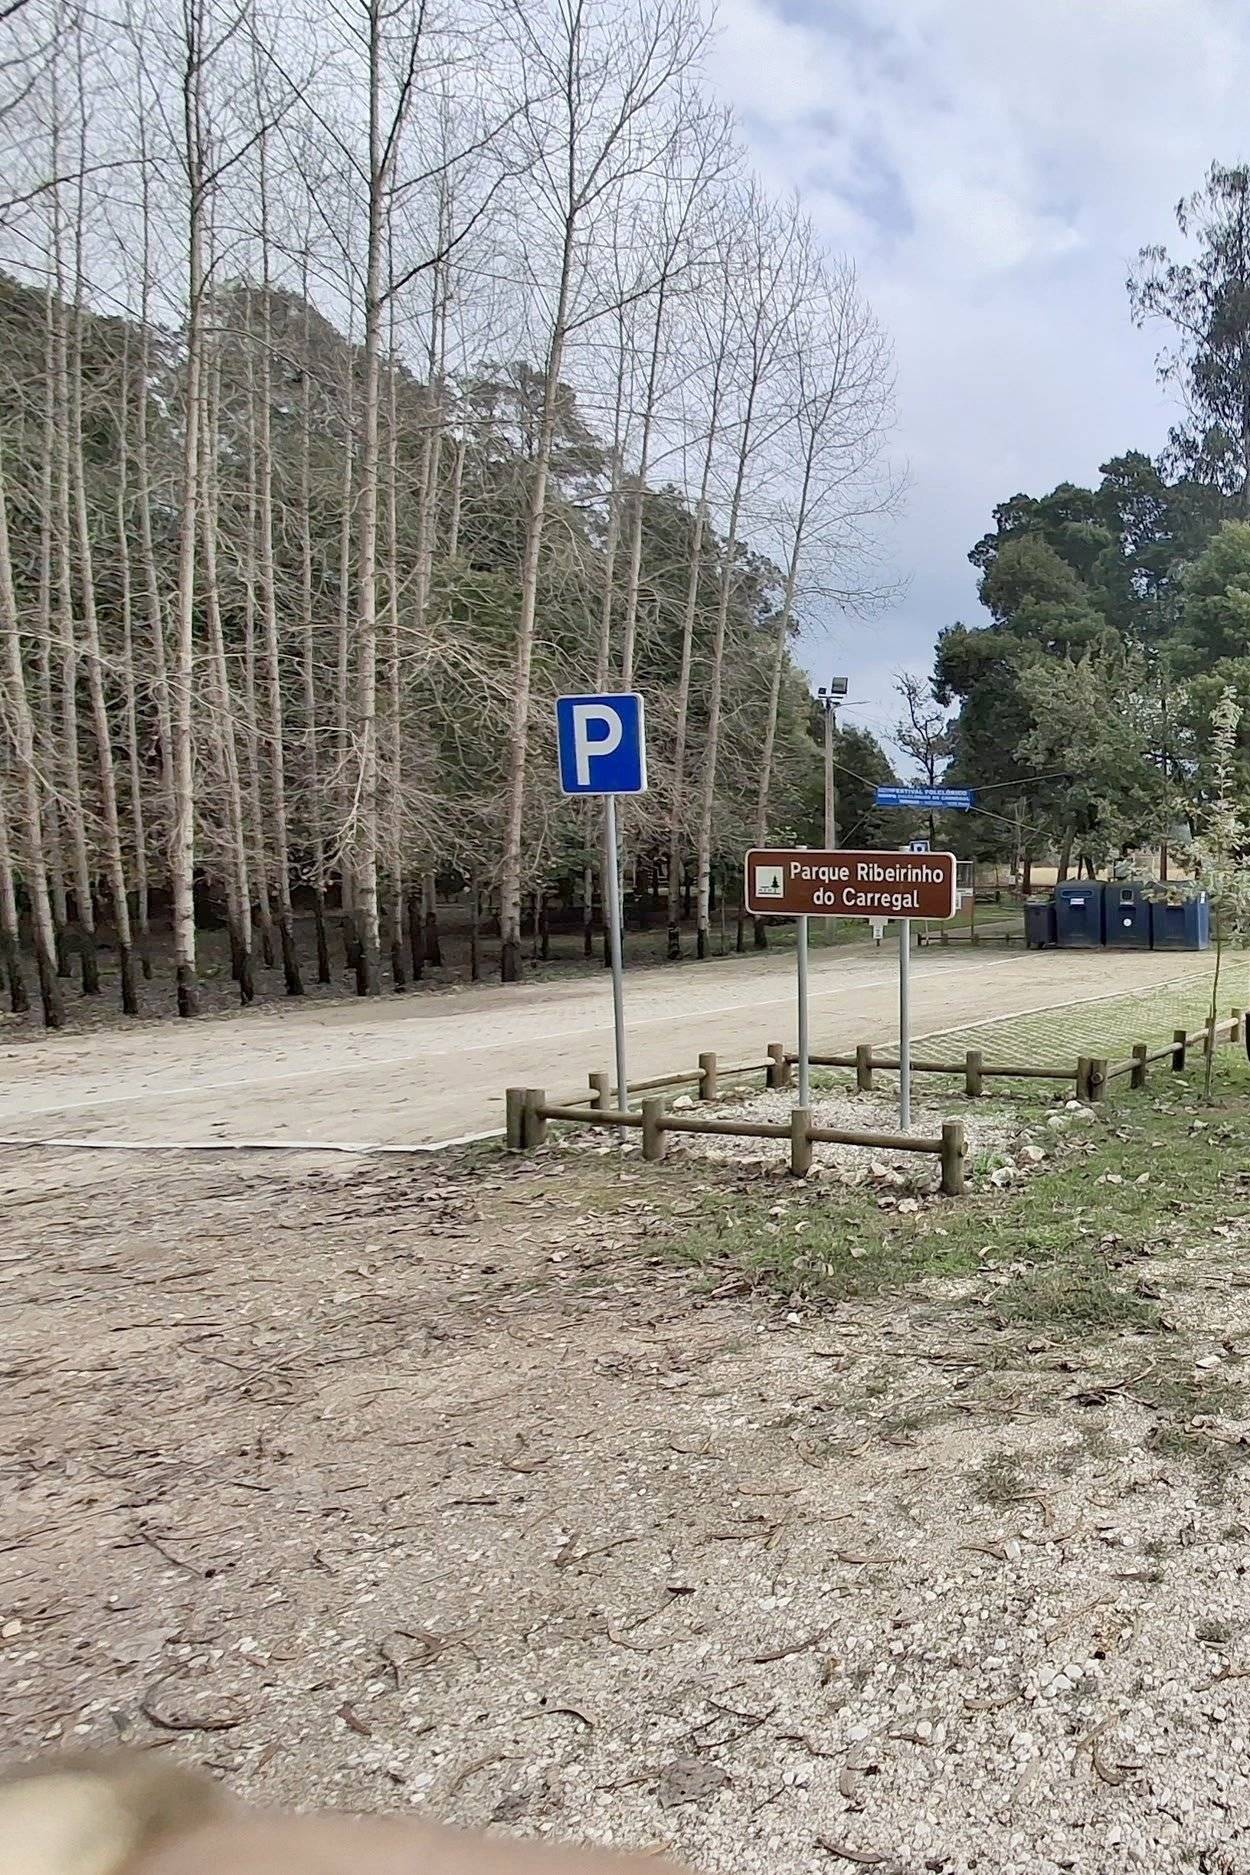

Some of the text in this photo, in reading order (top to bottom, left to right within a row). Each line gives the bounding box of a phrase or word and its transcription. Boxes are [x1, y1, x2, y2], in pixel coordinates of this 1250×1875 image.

[572, 704, 623, 786] P
[790, 861, 944, 884] Parque Ribeirinho
[813, 887, 920, 911] do Carregal
